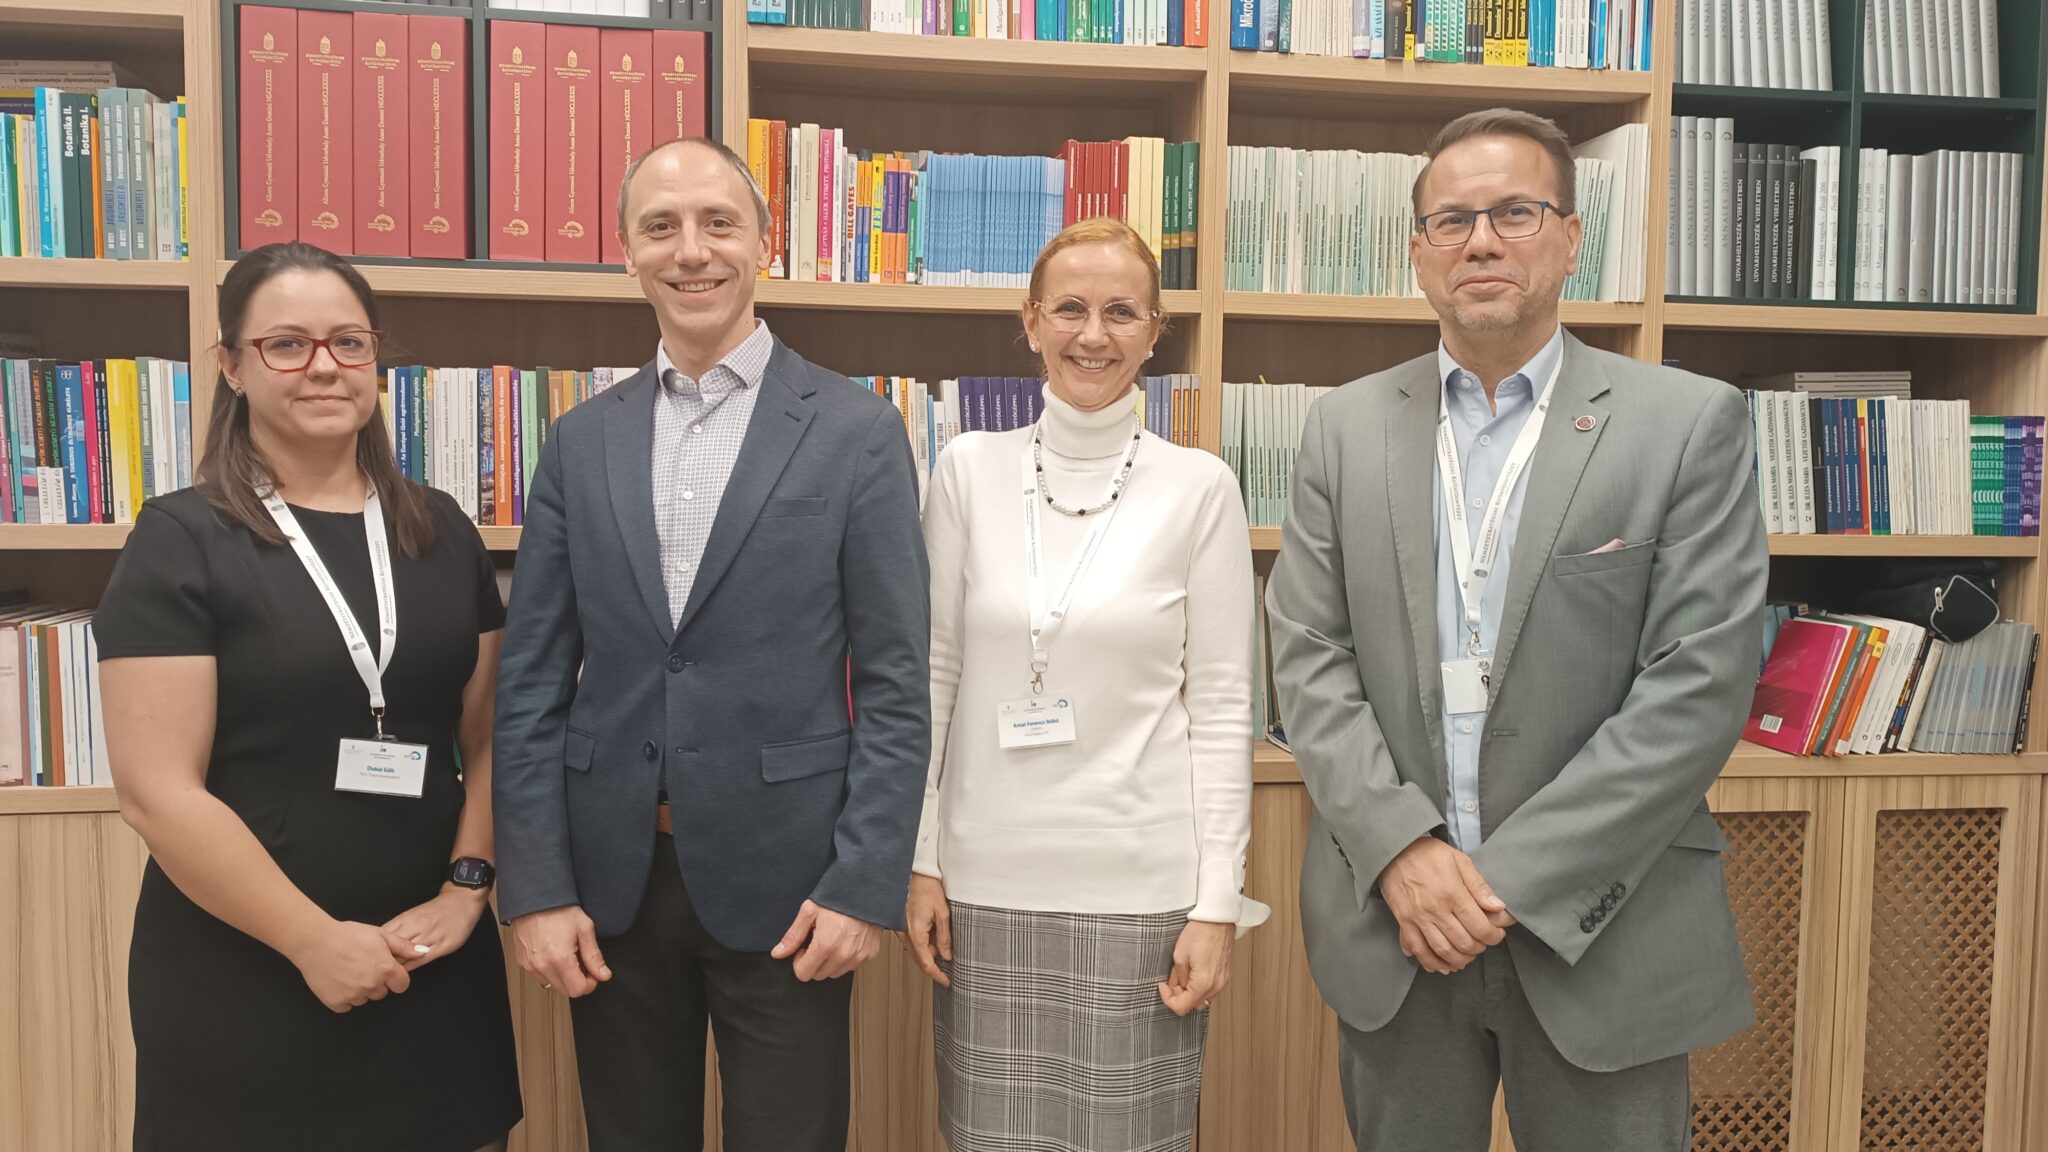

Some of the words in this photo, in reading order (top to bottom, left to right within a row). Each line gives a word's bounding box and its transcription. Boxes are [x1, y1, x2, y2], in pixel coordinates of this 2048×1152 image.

[64, 116, 73, 157] Botanika
[81, 115, 90, 155] Botanika
[1753, 223, 1761, 282] UDVARHELYSZÉK
[1771, 224, 1779, 282] UDVARHELYSZÉK
[1786, 224, 1794, 283] UDVARHELYSZÉK
[66, 414, 74, 445] ÁLTALÁNOS
